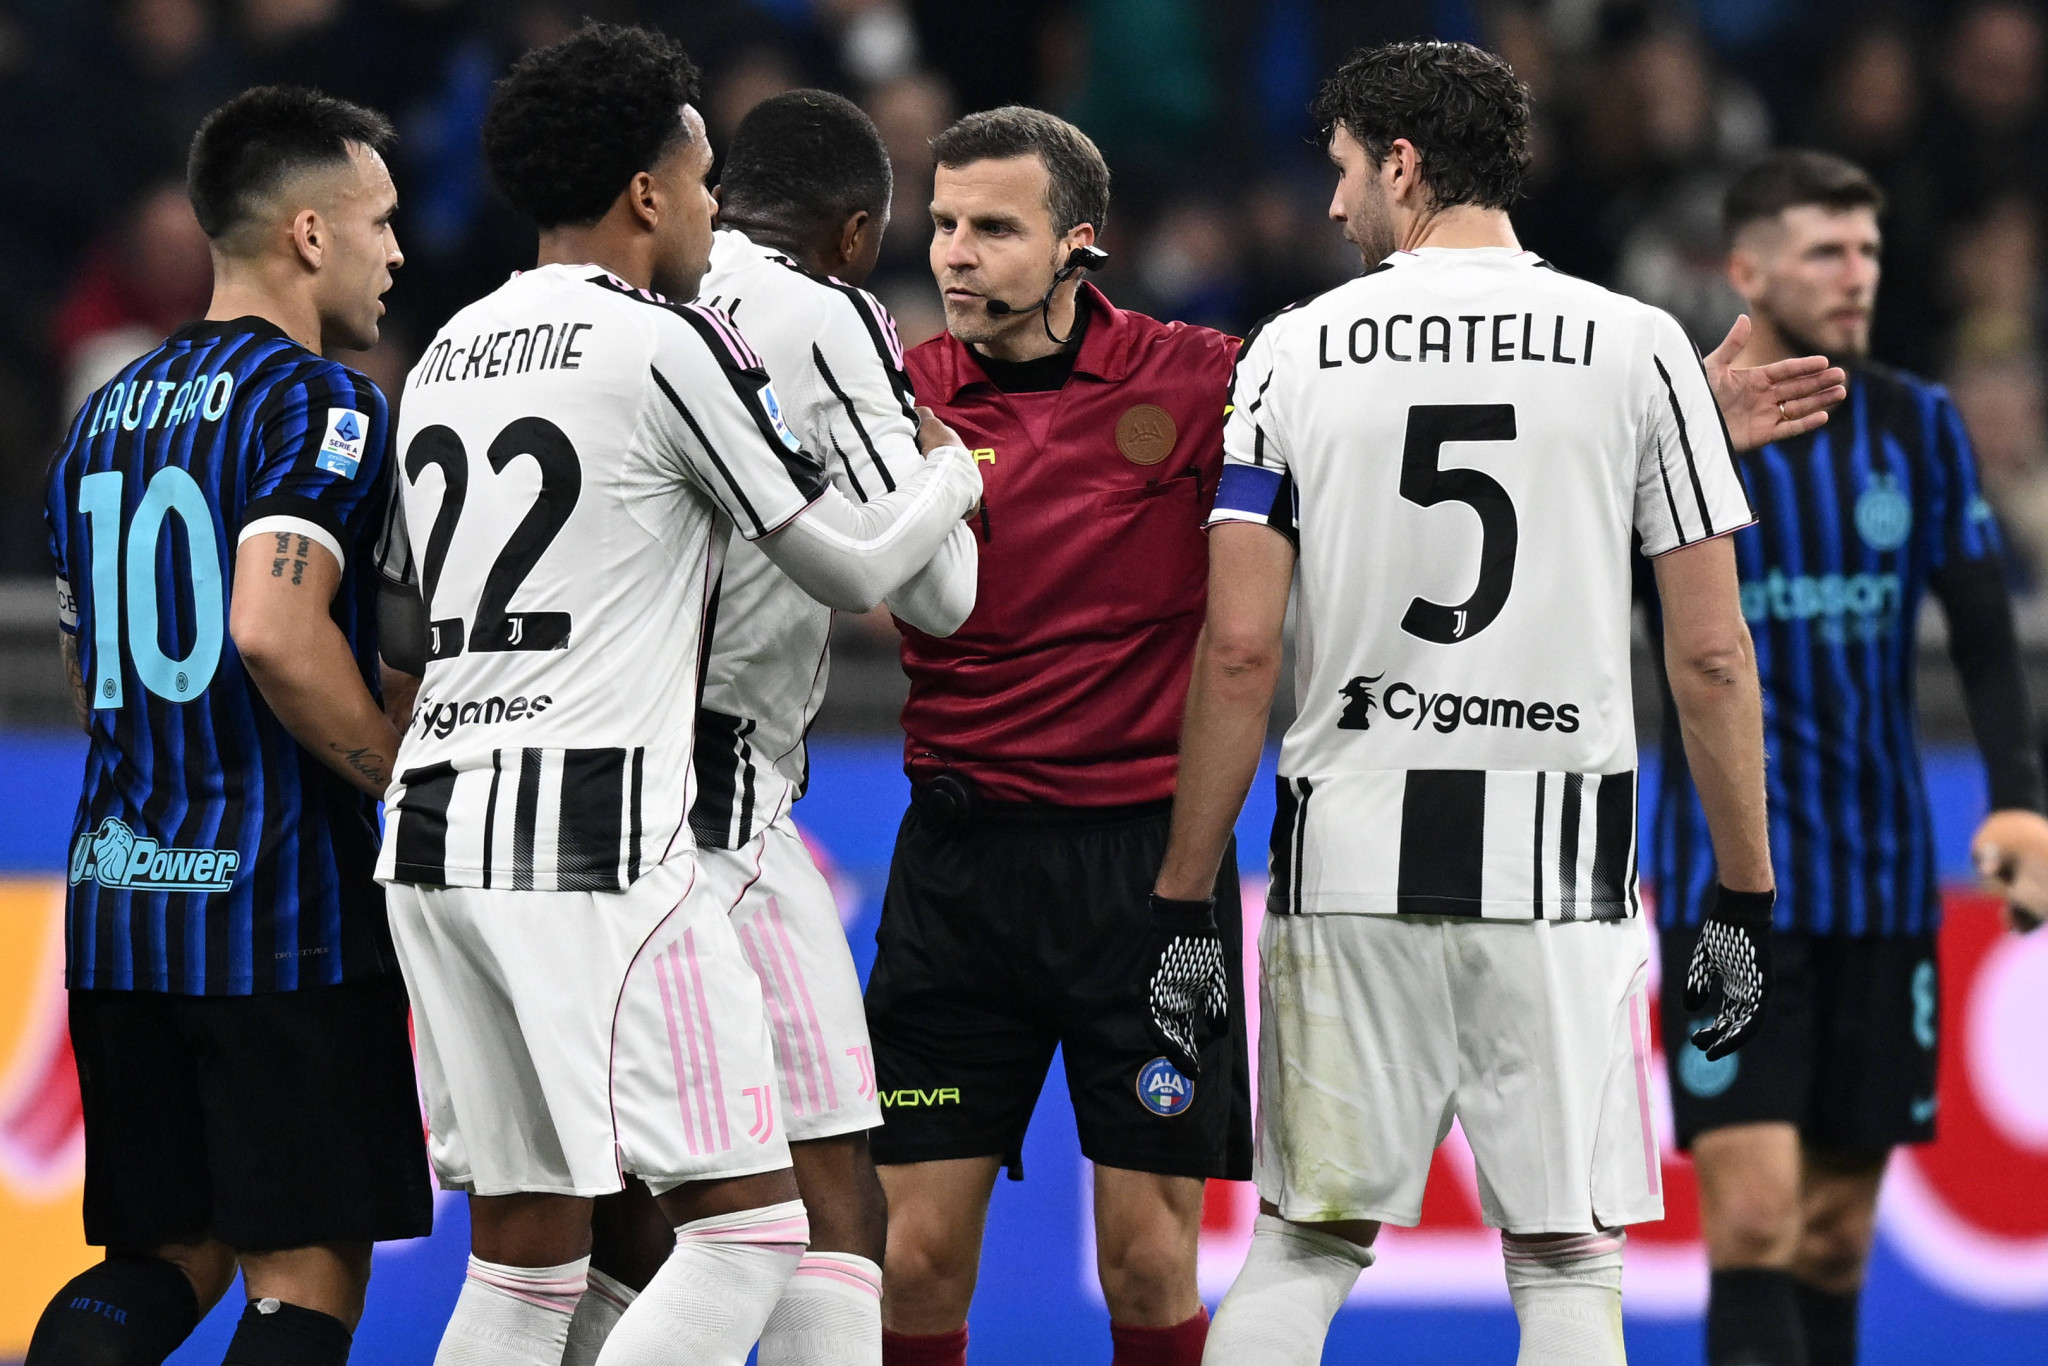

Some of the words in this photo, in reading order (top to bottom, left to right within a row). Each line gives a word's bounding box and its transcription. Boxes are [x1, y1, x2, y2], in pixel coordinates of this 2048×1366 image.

[1319, 313, 1595, 369] LOCATELLI
[87, 371, 234, 439] LAUTARO
[329, 438, 352, 452] SERIE
[351, 447, 358, 455] A
[404, 416, 582, 663] 22
[1399, 403, 1518, 645] 5
[78, 465, 224, 710] 10
[1382, 682, 1580, 734] Cygames
[121, 838, 239, 886] Power
[1148, 1072, 1185, 1095] AIA
